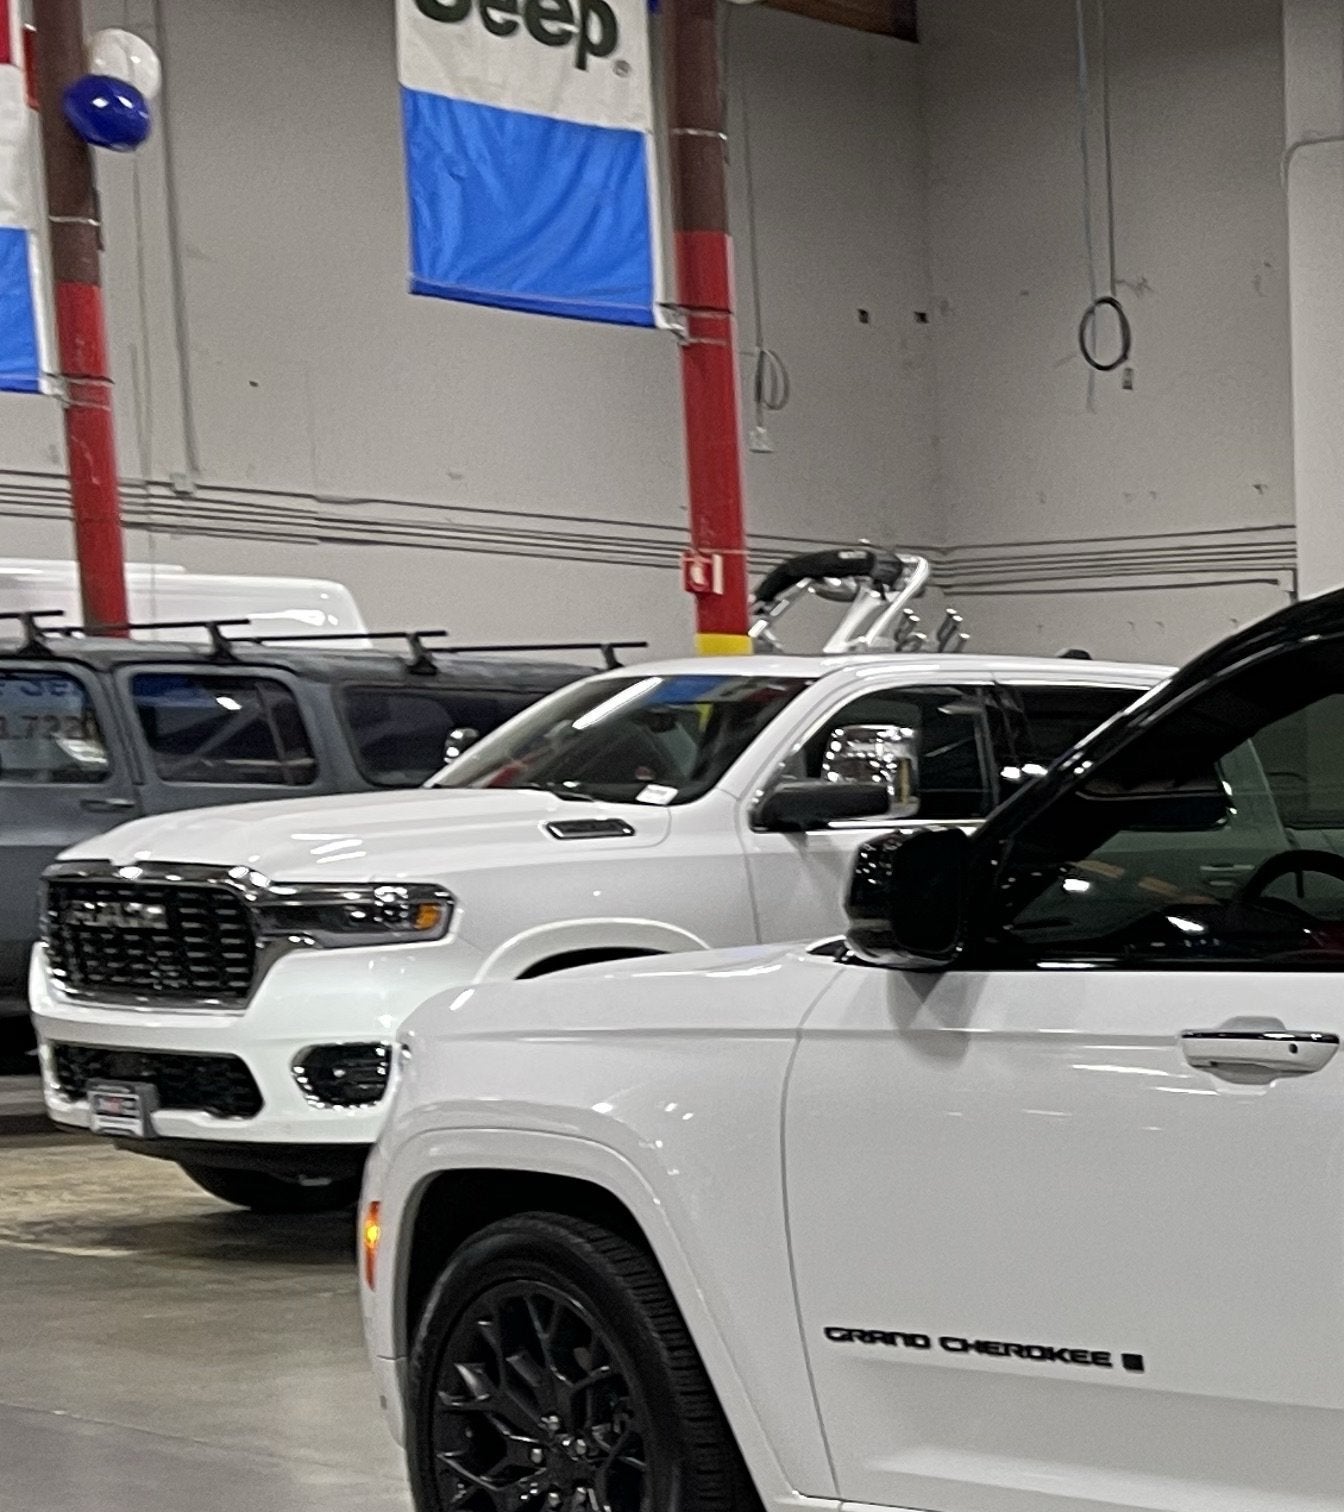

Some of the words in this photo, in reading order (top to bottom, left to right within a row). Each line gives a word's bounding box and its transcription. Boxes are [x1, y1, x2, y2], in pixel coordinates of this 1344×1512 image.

[415, 0, 618, 71] eep
[824, 1326, 931, 1349] GRAND
[938, 1336, 1113, 1368] CHEROKEE
